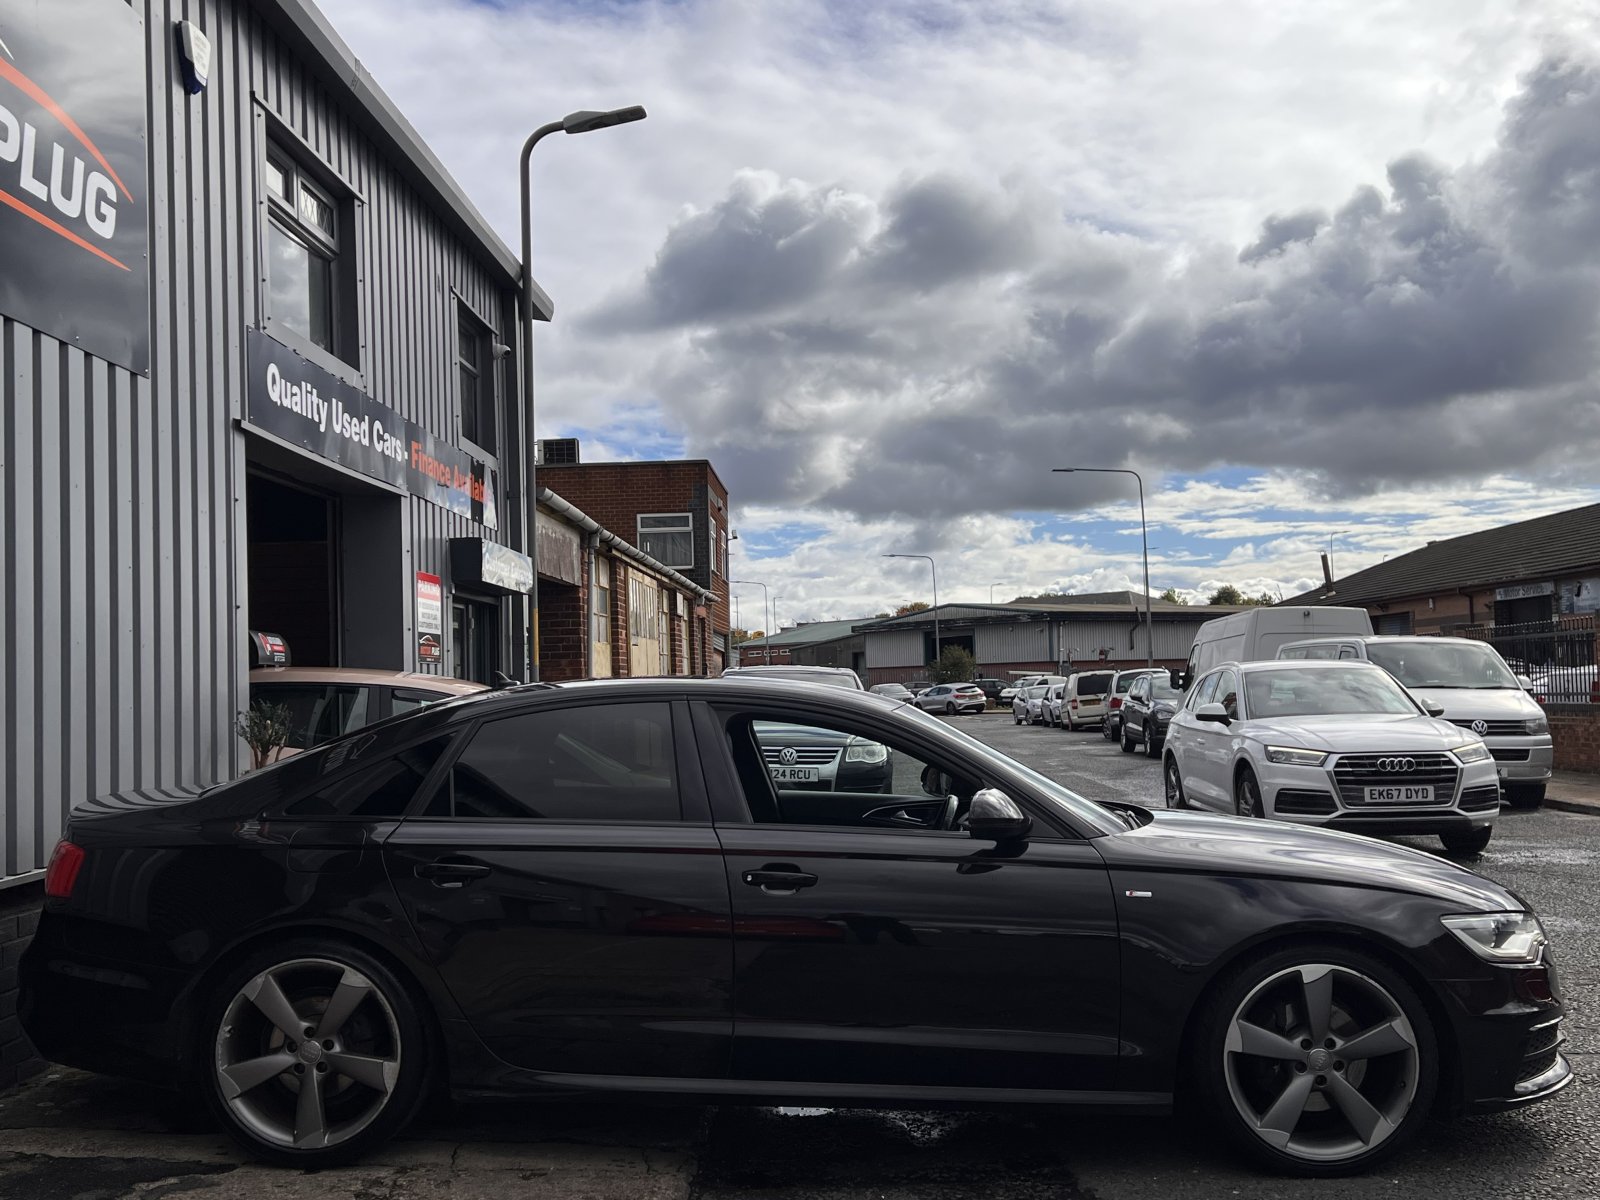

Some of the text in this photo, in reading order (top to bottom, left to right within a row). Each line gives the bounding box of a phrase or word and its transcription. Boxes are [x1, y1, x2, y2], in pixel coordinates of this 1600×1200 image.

[266, 362, 328, 433] Quality
[331, 397, 369, 446] Used
[372, 420, 402, 463] Cars
[411, 440, 451, 486] Finance
[770, 768, 811, 780] 24 RCU
[1369, 787, 1429, 800] EK67 DYD
